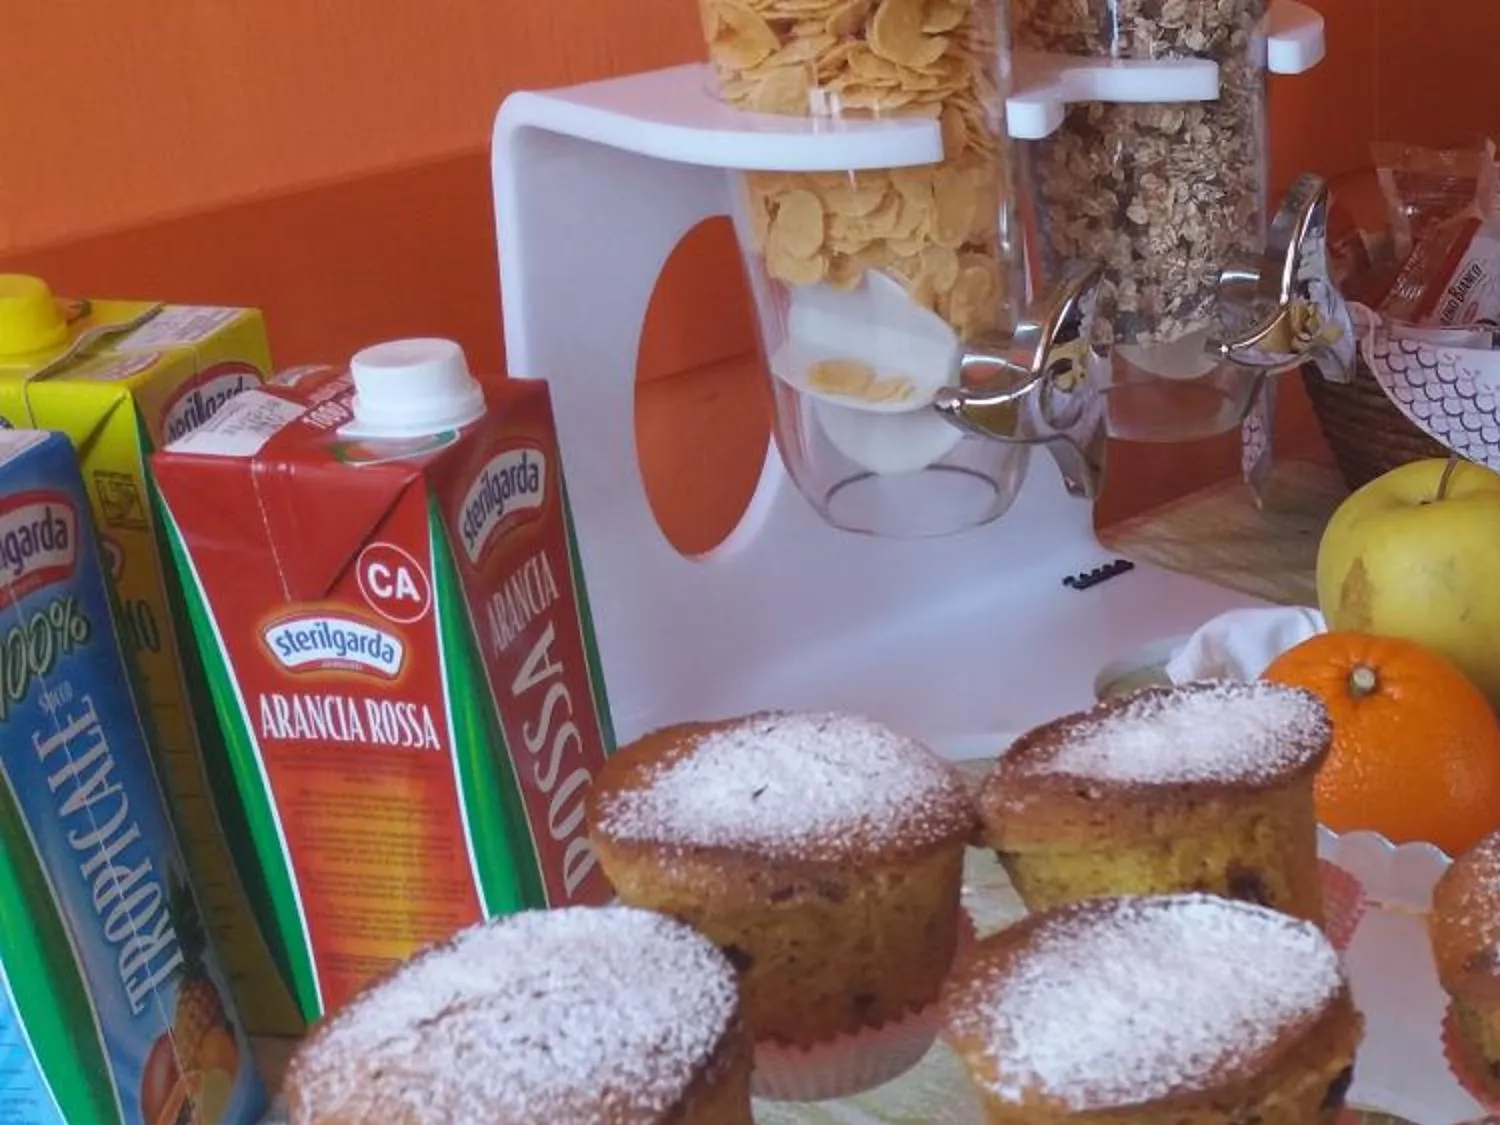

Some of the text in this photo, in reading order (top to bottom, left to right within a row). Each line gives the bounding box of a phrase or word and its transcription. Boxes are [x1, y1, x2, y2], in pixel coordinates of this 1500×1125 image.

[463, 450, 539, 550] sterilgarda
[366, 562, 422, 603] CA
[486, 549, 560, 658] ARANCIA
[275, 621, 396, 664] sterilgarda
[259, 692, 441, 751] ARANCIA ROSSA
[31, 695, 185, 1016] TROPICALE
